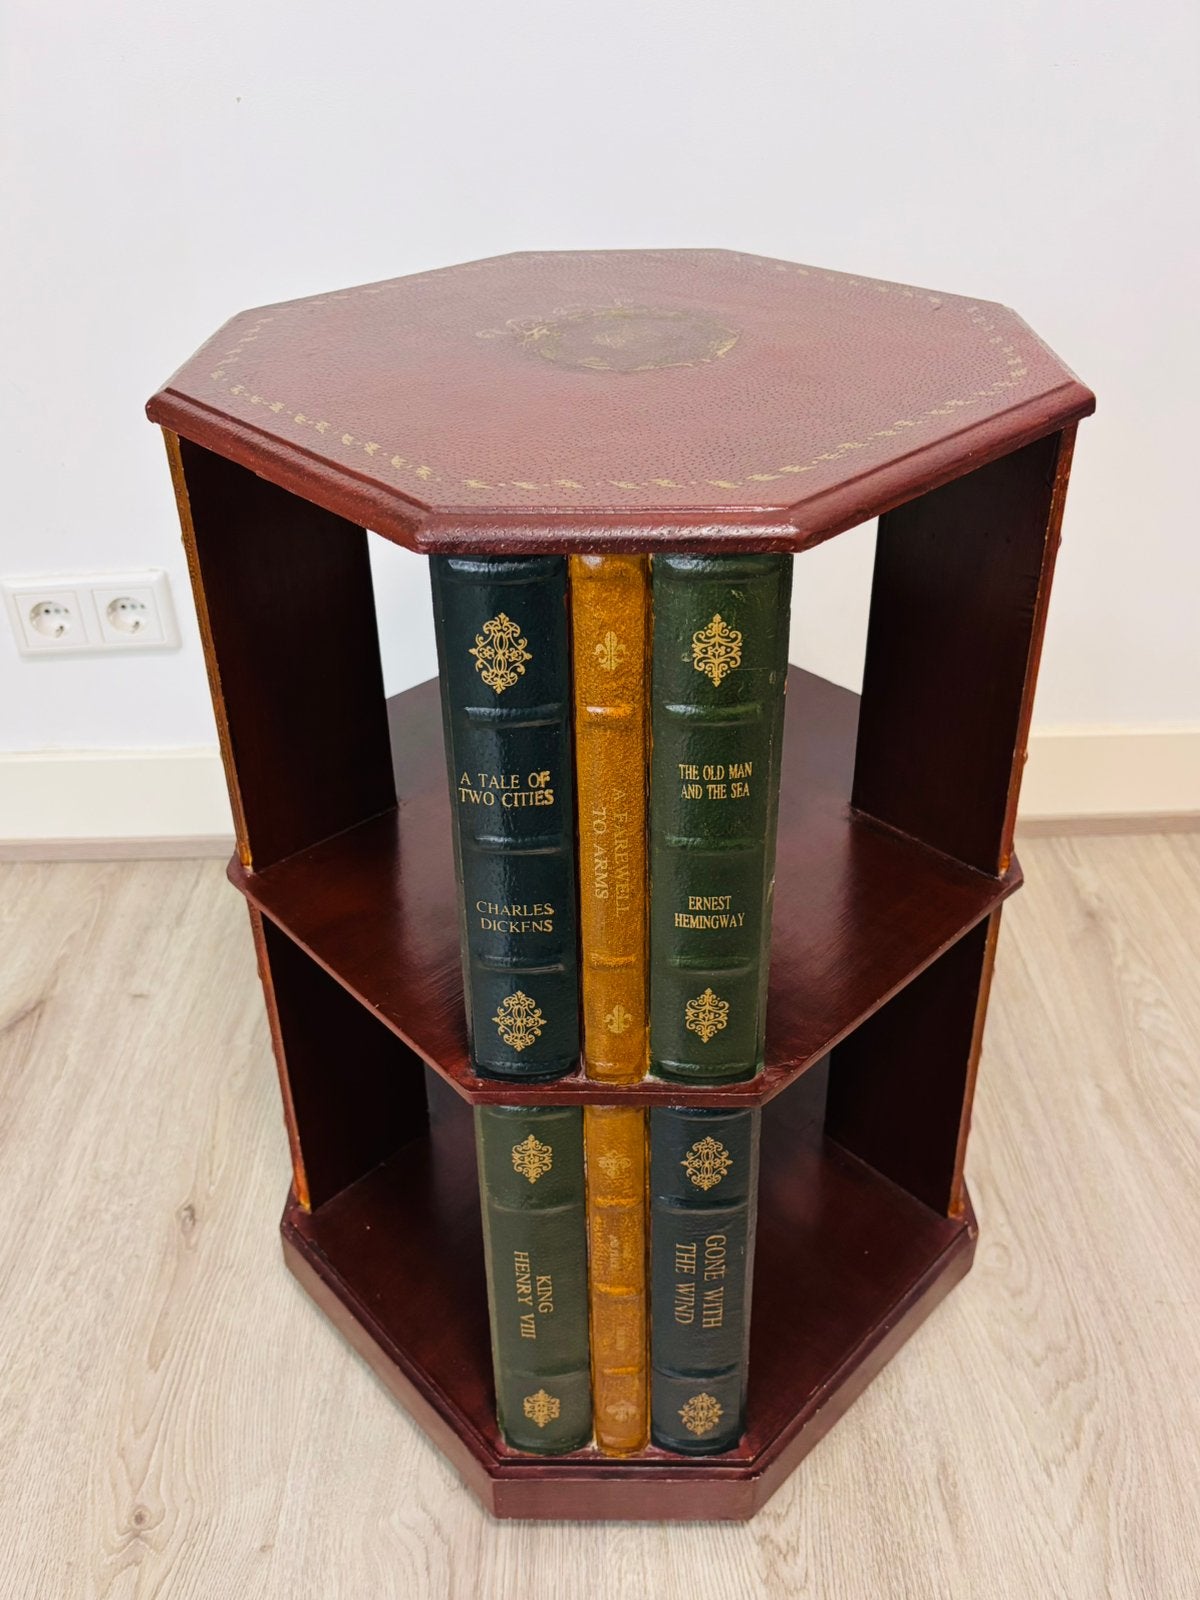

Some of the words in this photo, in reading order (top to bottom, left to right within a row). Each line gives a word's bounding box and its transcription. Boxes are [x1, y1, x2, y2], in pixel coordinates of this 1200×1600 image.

[460, 771, 472, 786] A
[478, 773, 520, 789] TALE
[527, 770, 551, 789] OF
[678, 763, 700, 780] THE
[702, 764, 725, 781] OLD
[728, 761, 753, 780] MAN
[458, 787, 495, 806] TWO
[501, 788, 555, 807] CITIES
[612, 788, 626, 802] A
[681, 783, 703, 800] AND
[706, 783, 727, 800] THE
[730, 782, 750, 799] SEA
[592, 806, 607, 835] TO
[593, 843, 609, 900] ARMS
[613, 811, 630, 918] FAREWELL
[476, 900, 555, 917] CHARLES
[688, 895, 732, 911] ERNEST
[674, 912, 745, 930] HEMINGWAY
[675, 1242, 697, 1275] THE
[704, 1234, 727, 1281] GONE
[513, 1250, 533, 1306] HENRY
[536, 1274, 554, 1313] KING
[674, 1282, 696, 1324] WIND
[702, 1286, 724, 1328] WITH
[520, 1312, 536, 1339] VIII
